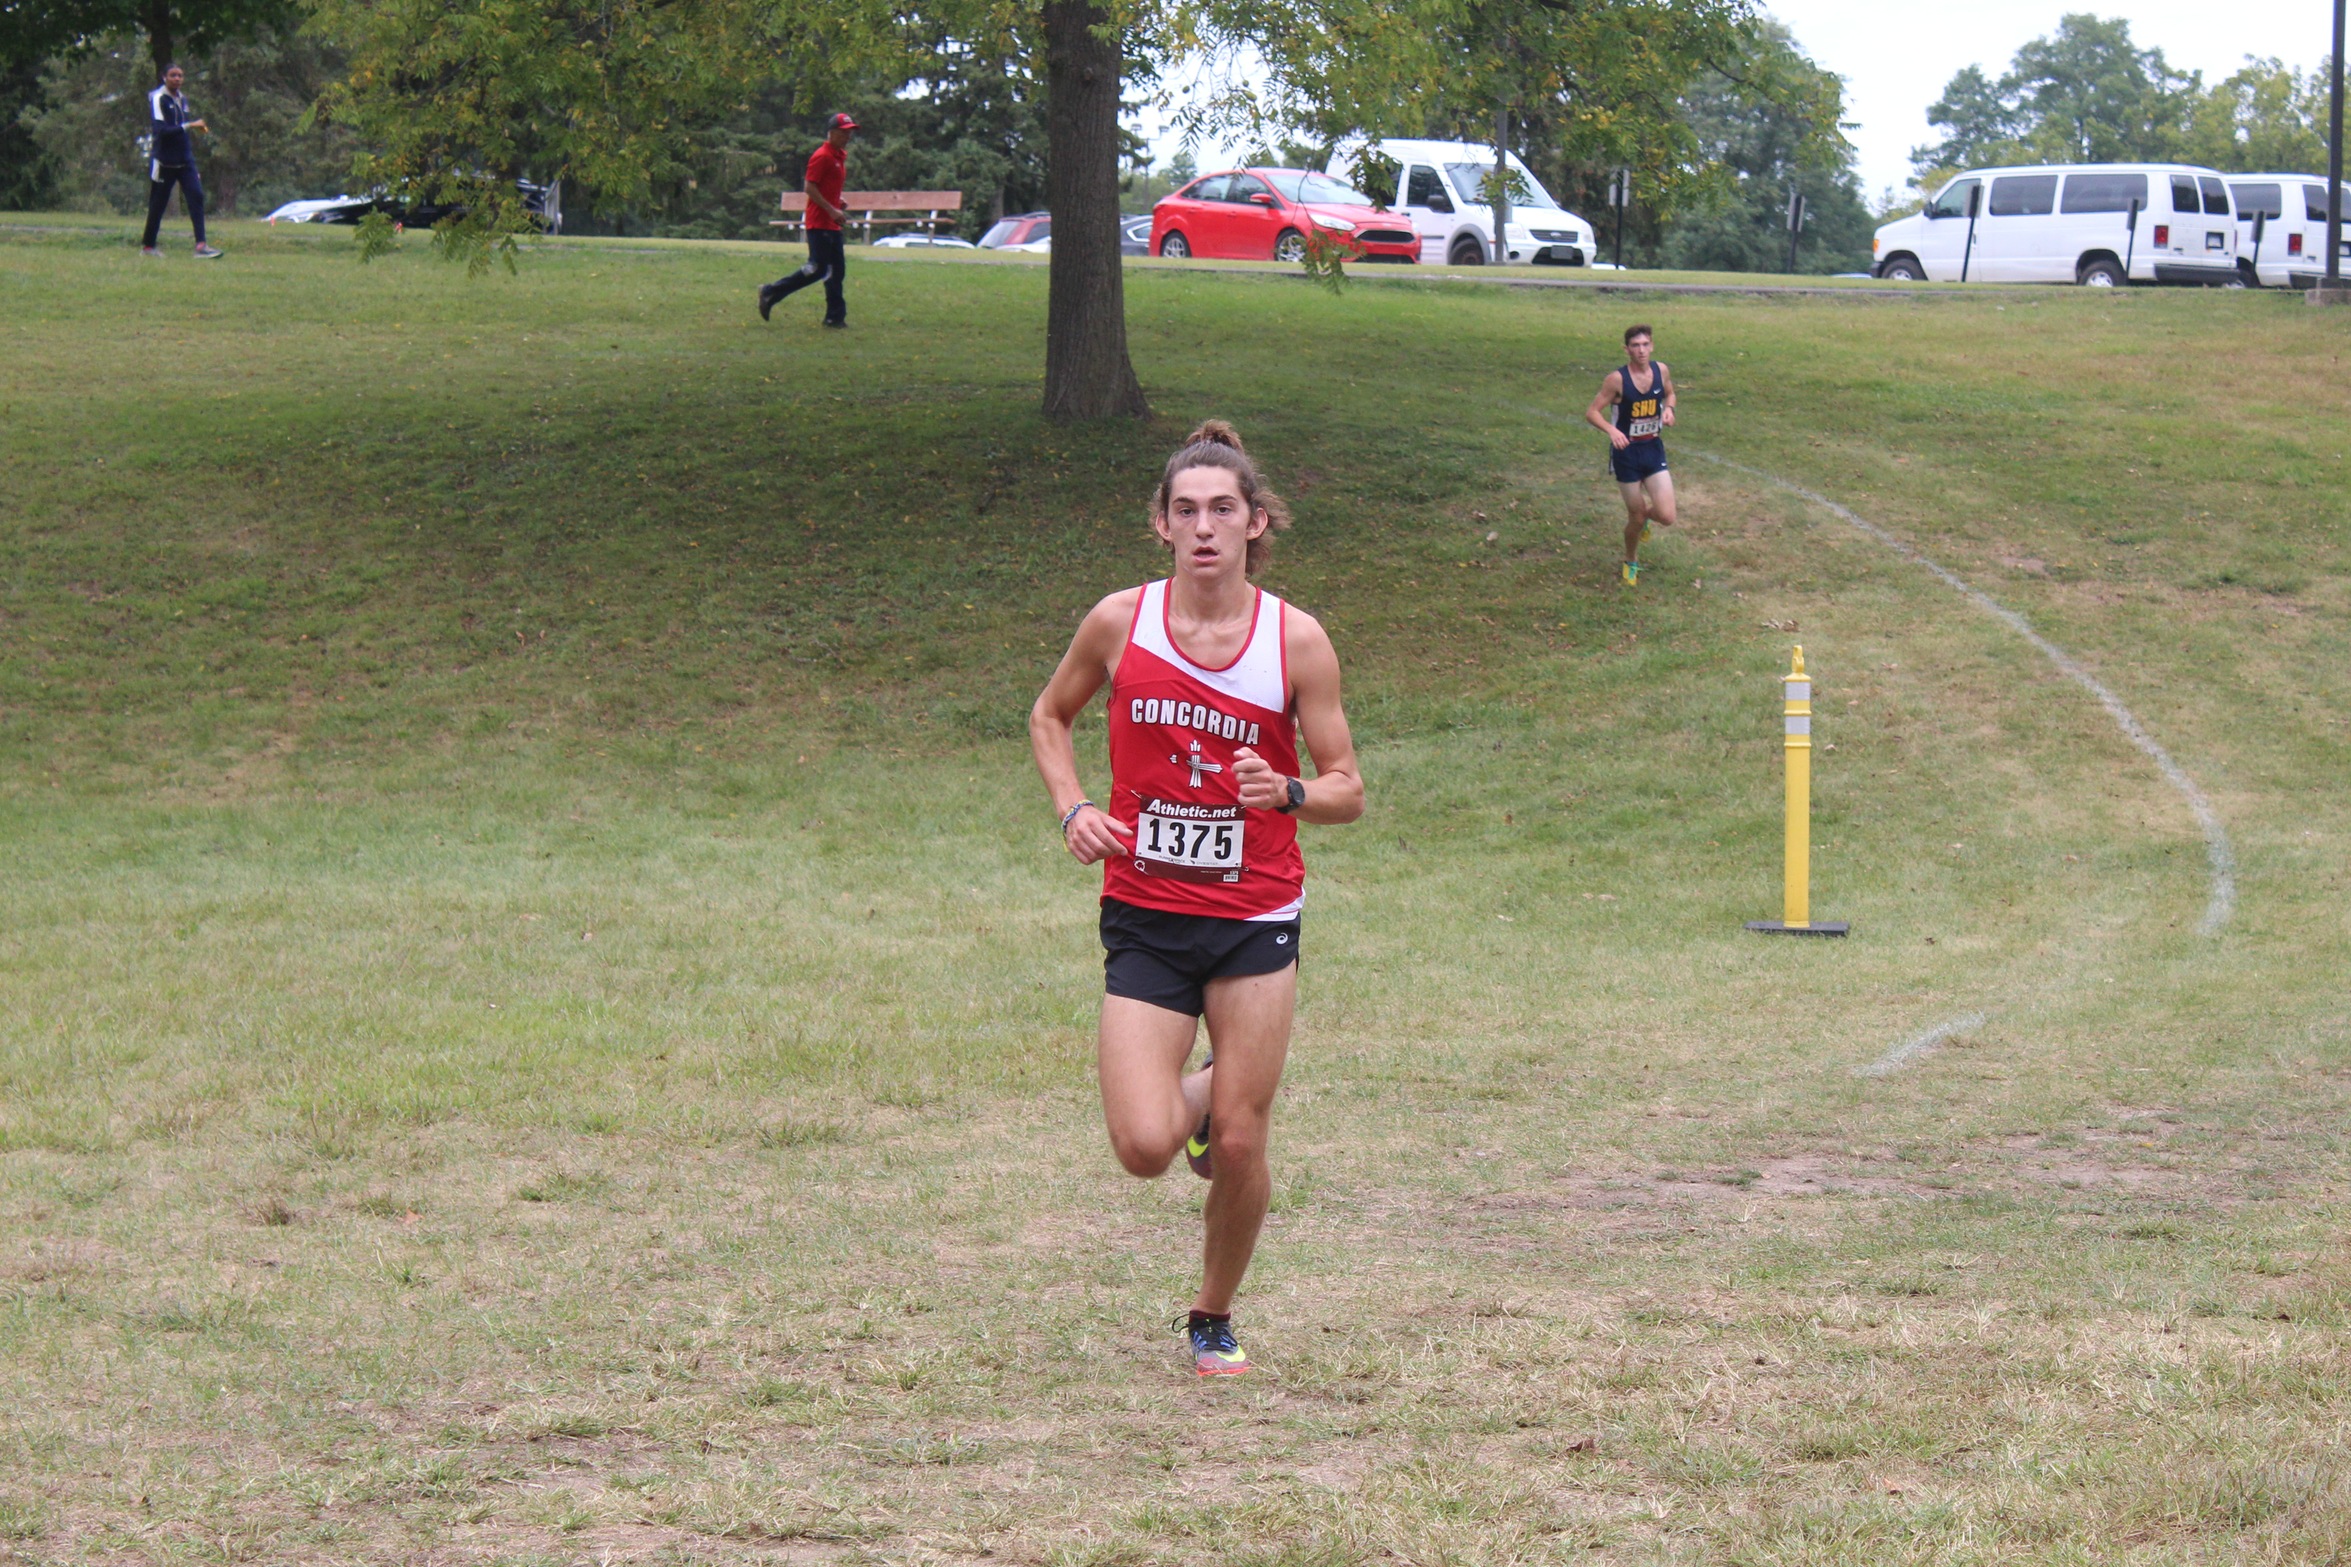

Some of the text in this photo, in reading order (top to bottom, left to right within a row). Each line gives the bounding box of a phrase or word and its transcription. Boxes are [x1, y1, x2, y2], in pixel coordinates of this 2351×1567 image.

[1632, 399, 1657, 417] SHU
[1131, 698, 1260, 745] CONCORDIA
[1146, 799, 1237, 818] Athletic.net
[1147, 818, 1233, 860] 1375
